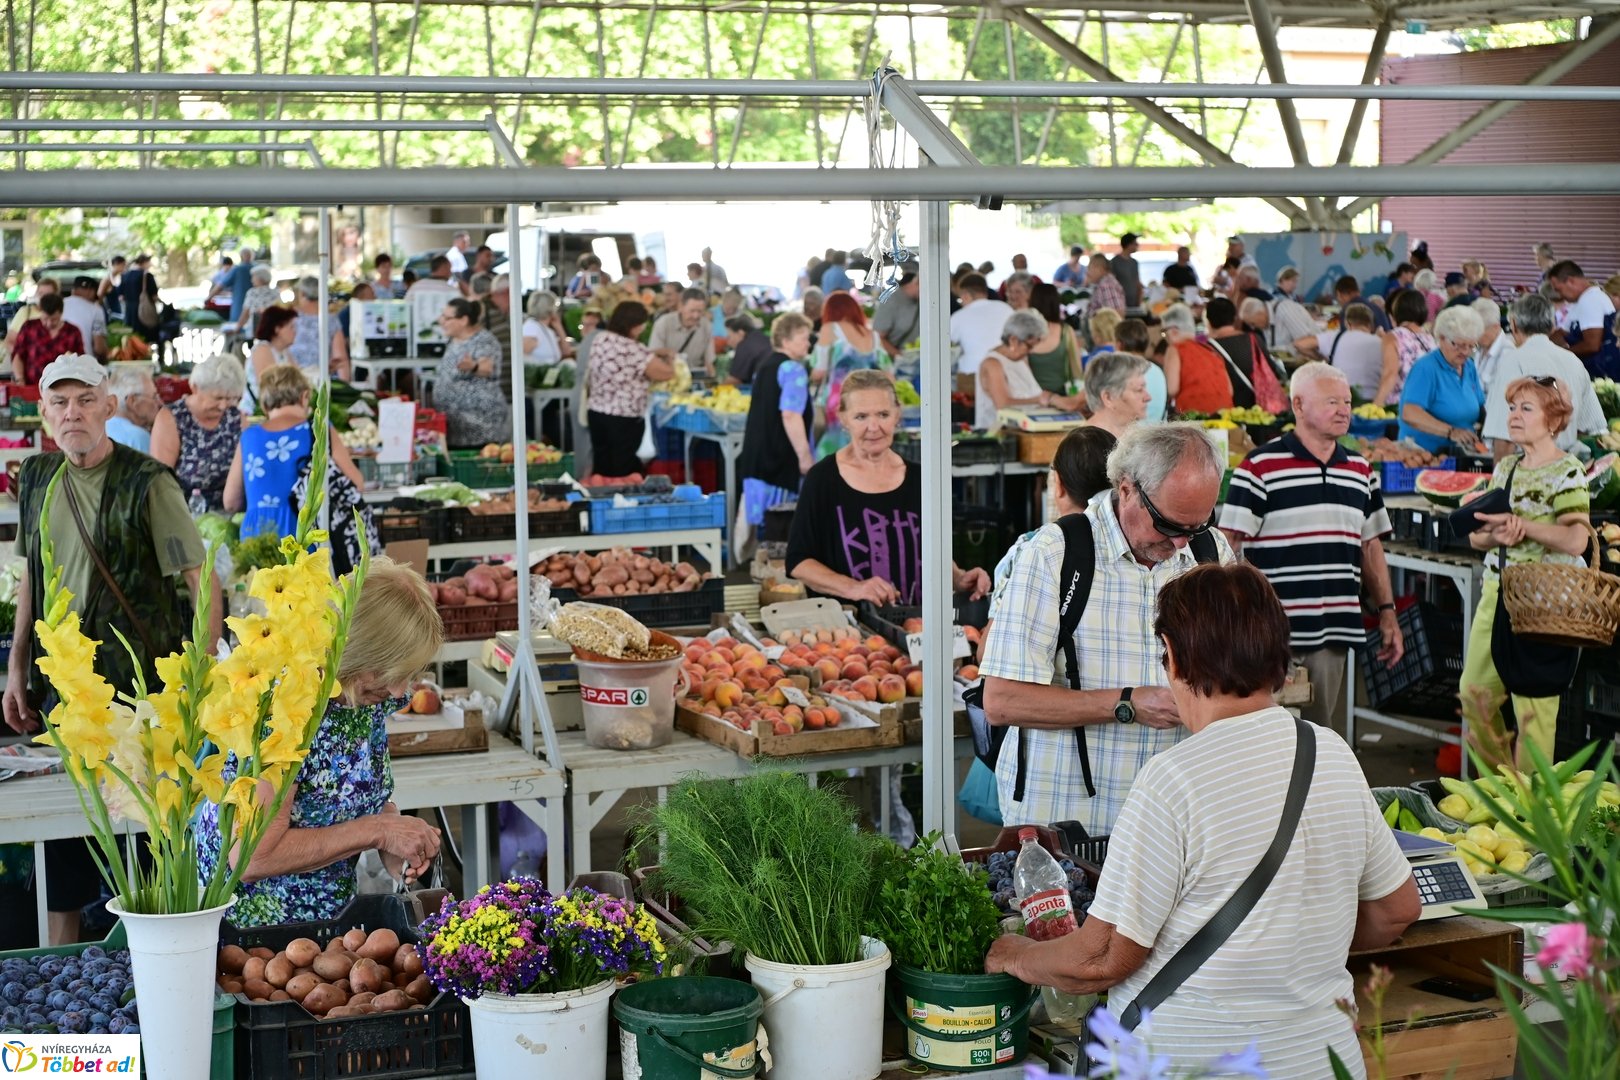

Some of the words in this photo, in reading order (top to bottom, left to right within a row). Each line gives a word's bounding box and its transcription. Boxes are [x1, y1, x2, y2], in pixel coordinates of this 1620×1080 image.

[580, 688, 626, 702] SPAR
[509, 777, 538, 795] 75
[942, 1018, 969, 1026] BOUILLON
[974, 1018, 991, 1026] CALDO
